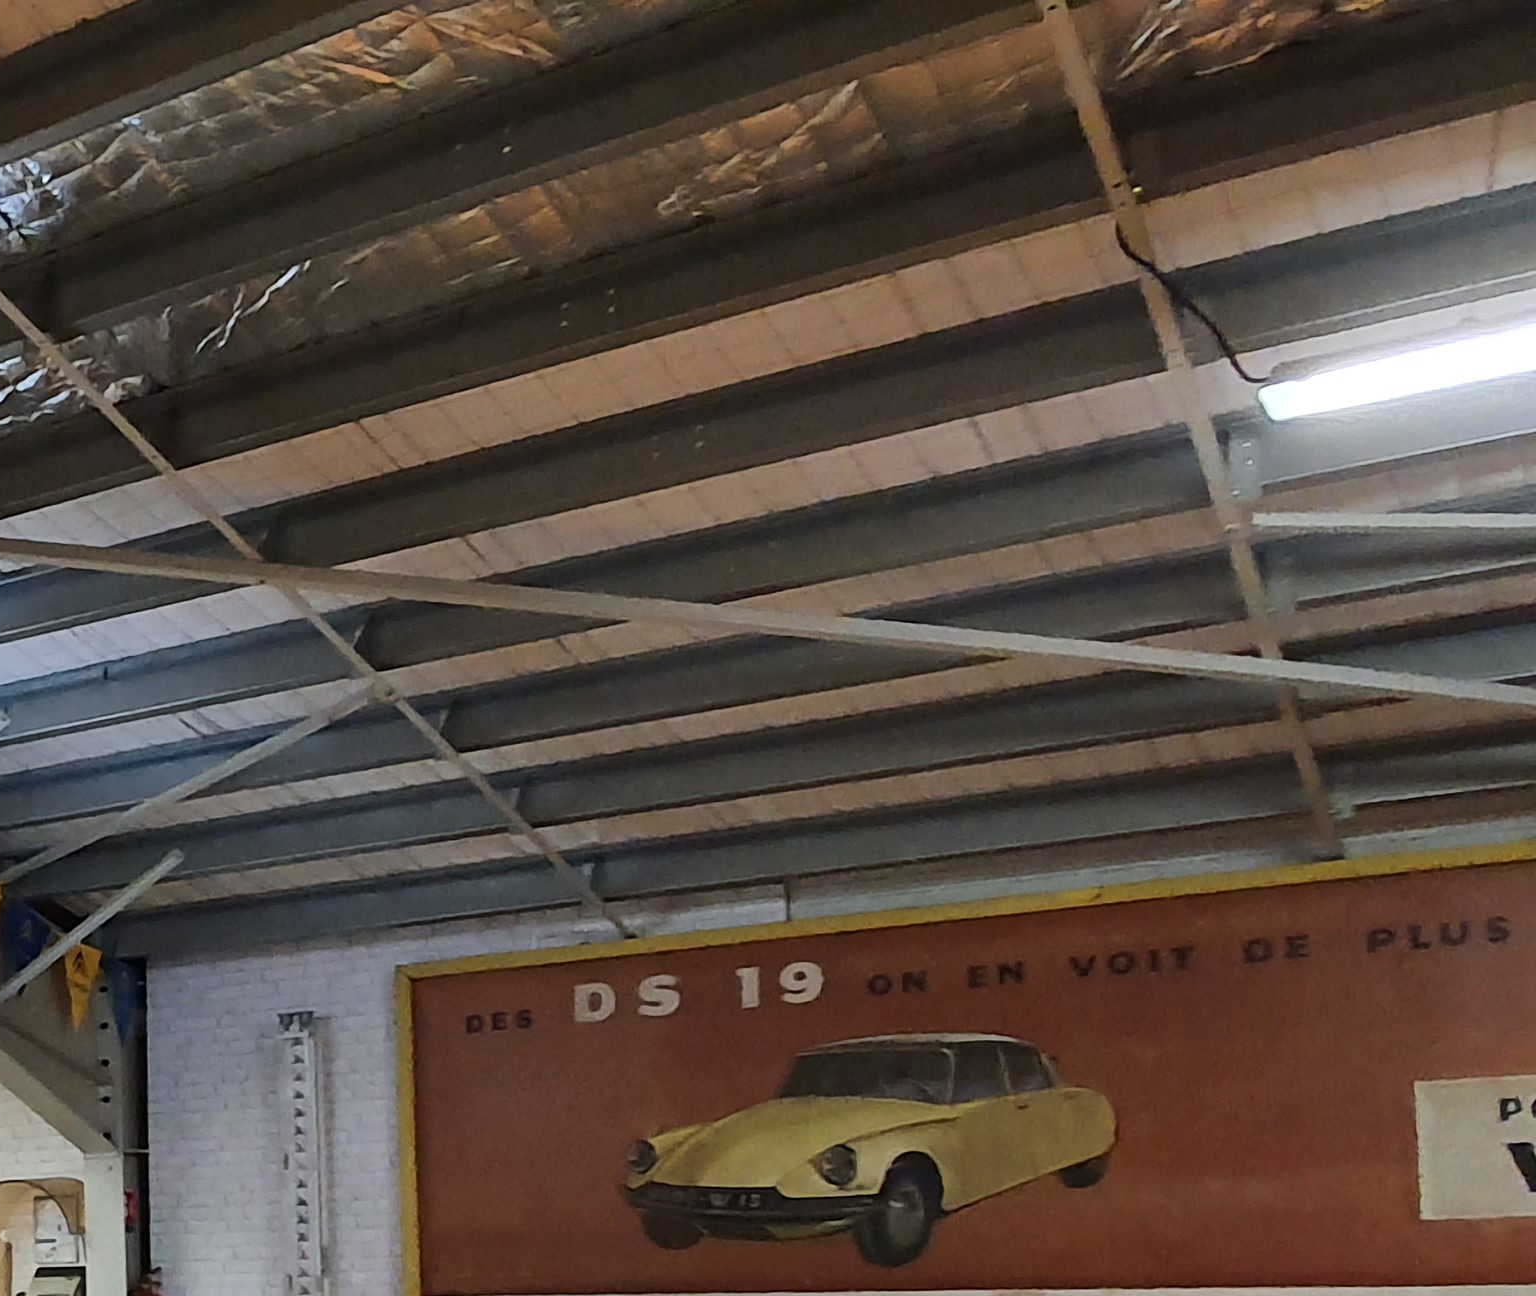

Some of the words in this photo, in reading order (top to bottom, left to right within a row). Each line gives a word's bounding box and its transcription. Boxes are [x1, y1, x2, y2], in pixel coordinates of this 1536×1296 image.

[464, 1009, 533, 1034] DES
[573, 974, 681, 1023] DS
[735, 961, 824, 1009] 19
[866, 970, 928, 997] ON
[965, 961, 1026, 989] EN
[1069, 944, 1196, 979] VOIT
[1242, 934, 1312, 965] DE
[1367, 915, 1512, 954] PLUS
